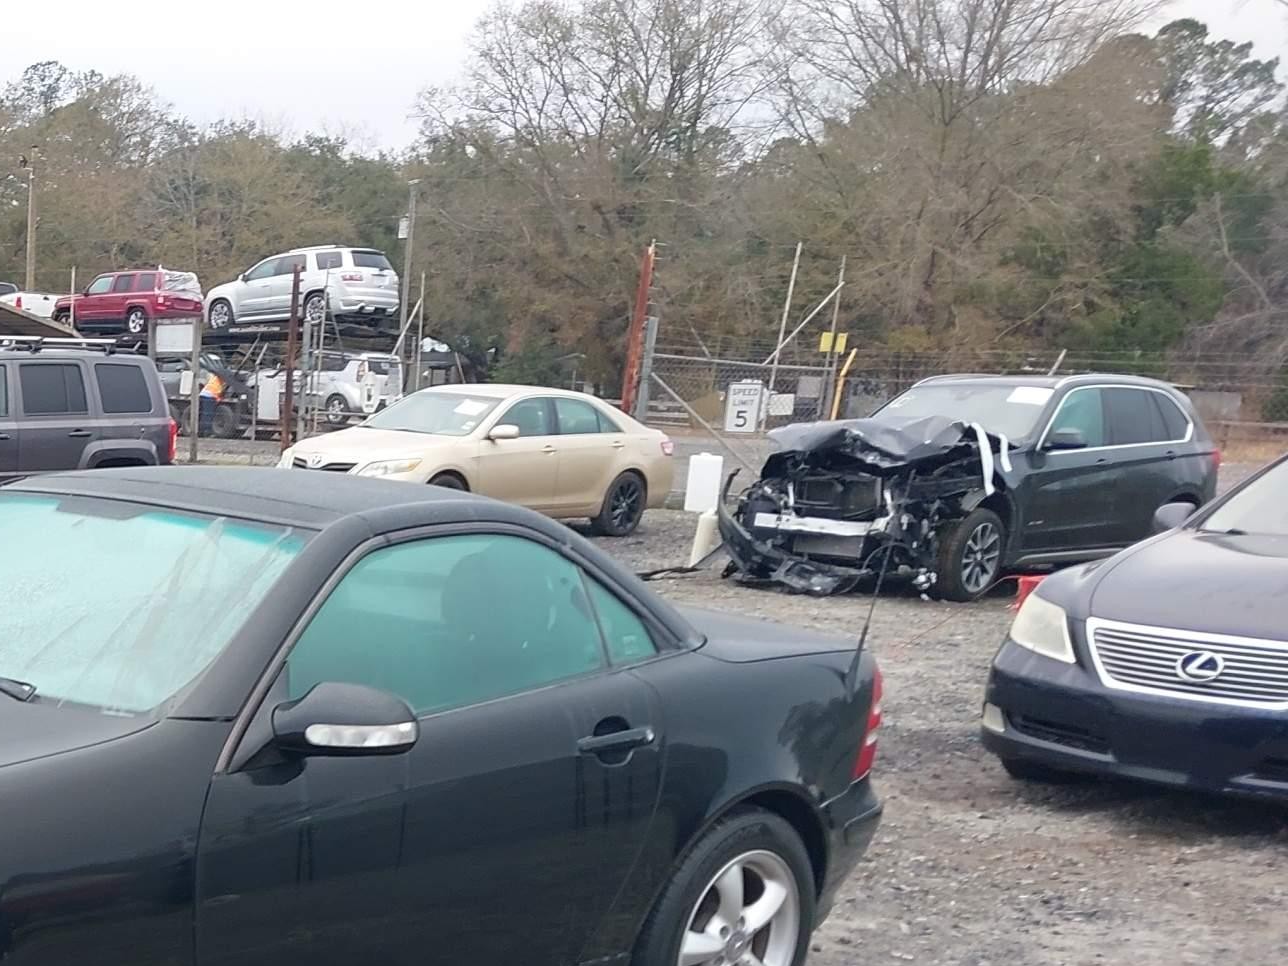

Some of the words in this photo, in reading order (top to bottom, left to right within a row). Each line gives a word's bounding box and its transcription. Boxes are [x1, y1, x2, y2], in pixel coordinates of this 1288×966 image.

[732, 388, 759, 396] SPEED
[732, 399, 754, 407] LIMIT
[734, 410, 748, 427] 5
